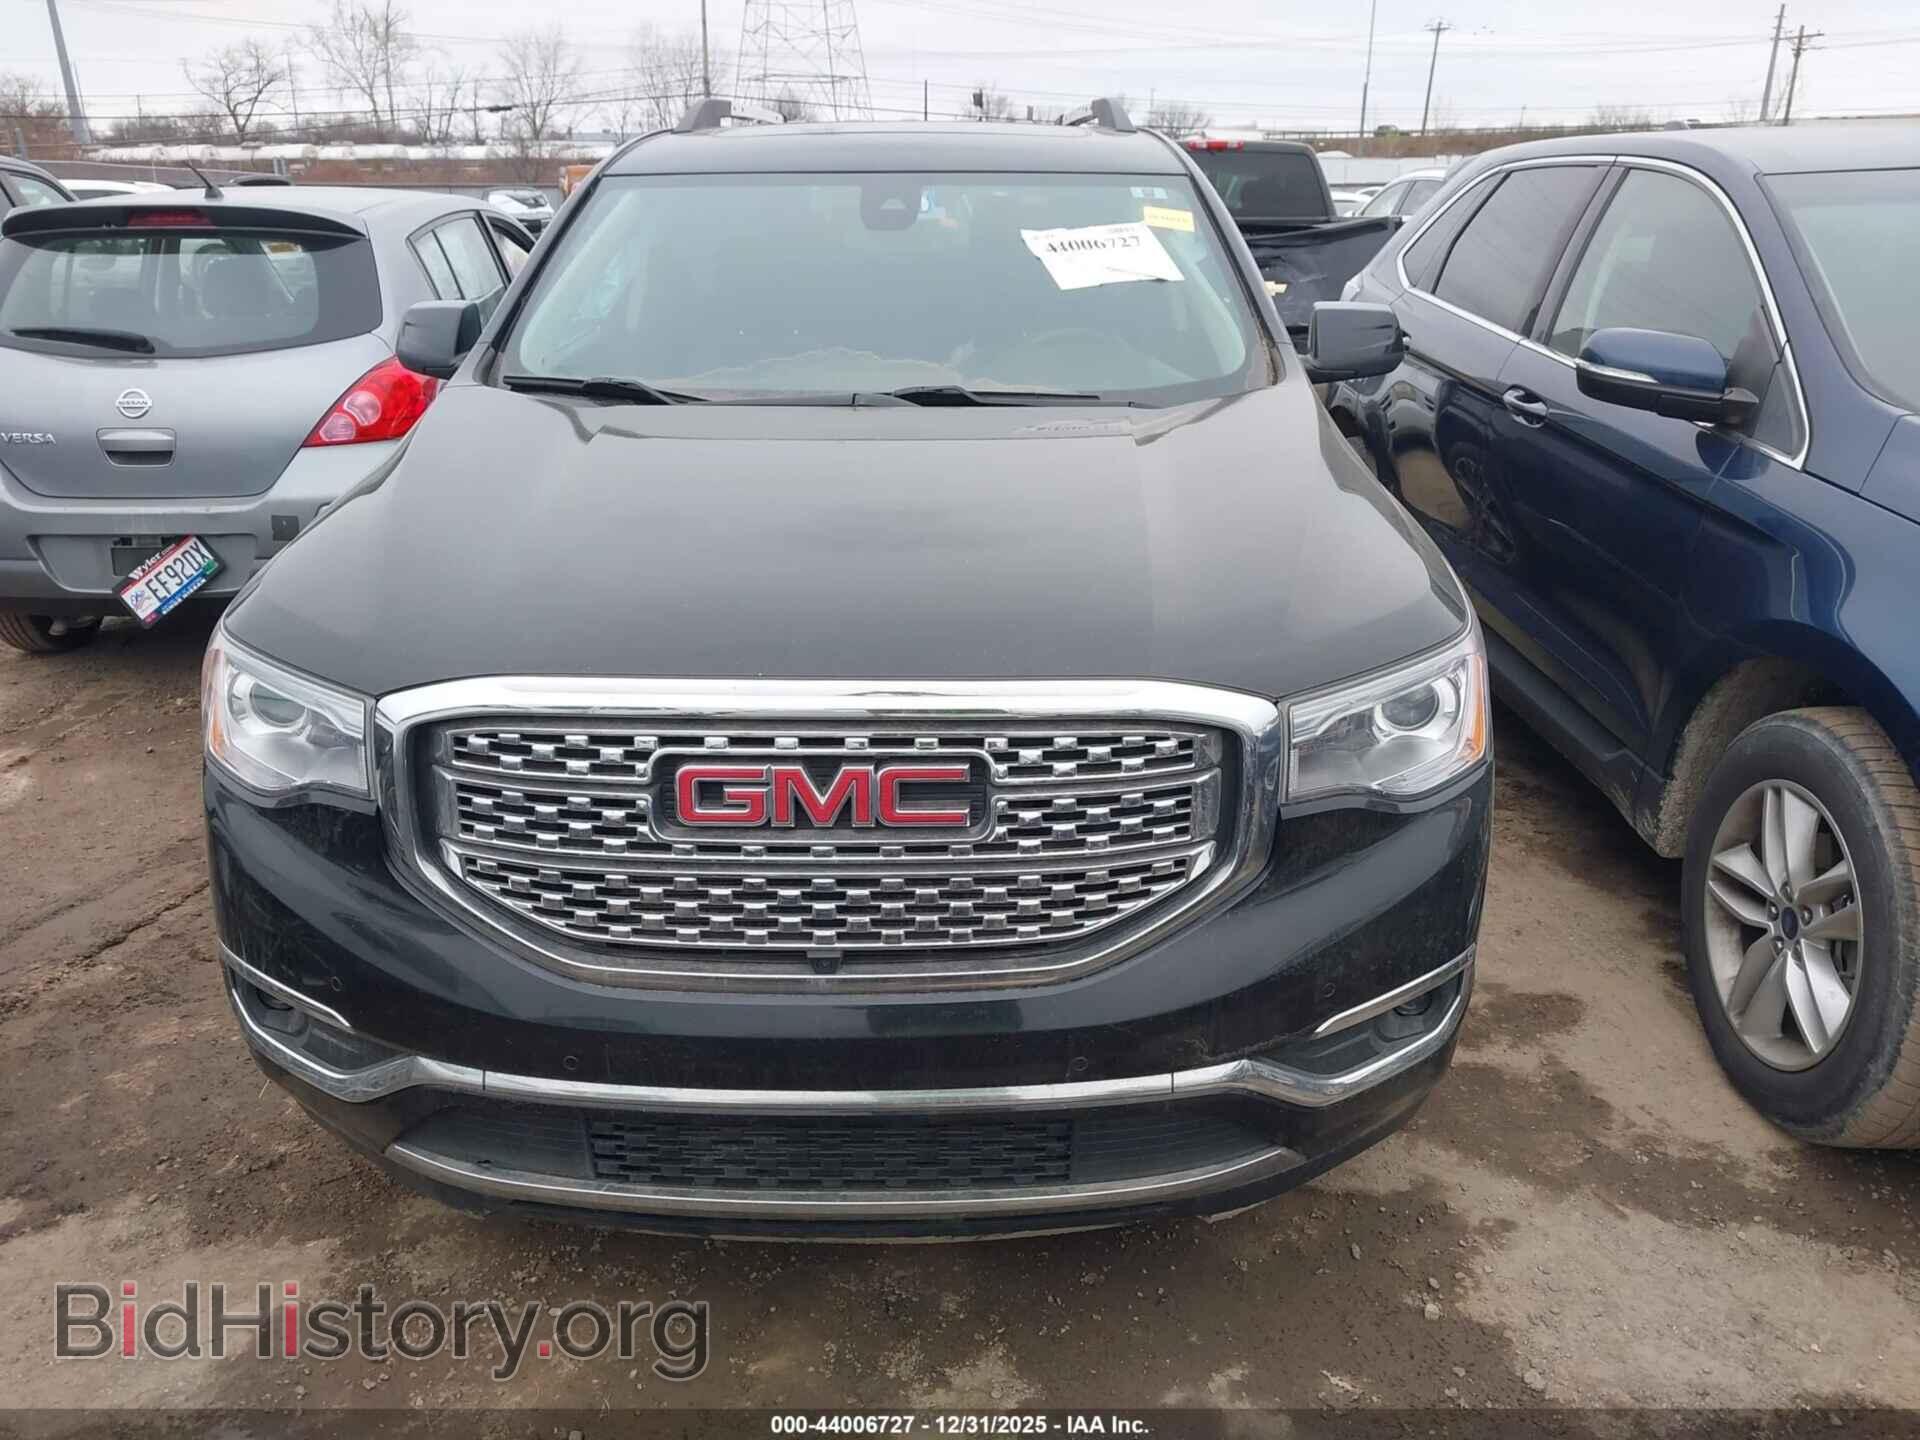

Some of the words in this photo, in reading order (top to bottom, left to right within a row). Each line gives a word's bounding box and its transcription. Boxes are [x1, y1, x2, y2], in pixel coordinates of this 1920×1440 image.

[1046, 235, 1141, 254] 44006727
[0, 432, 57, 445] VERSA
[675, 763, 970, 828] GMC
